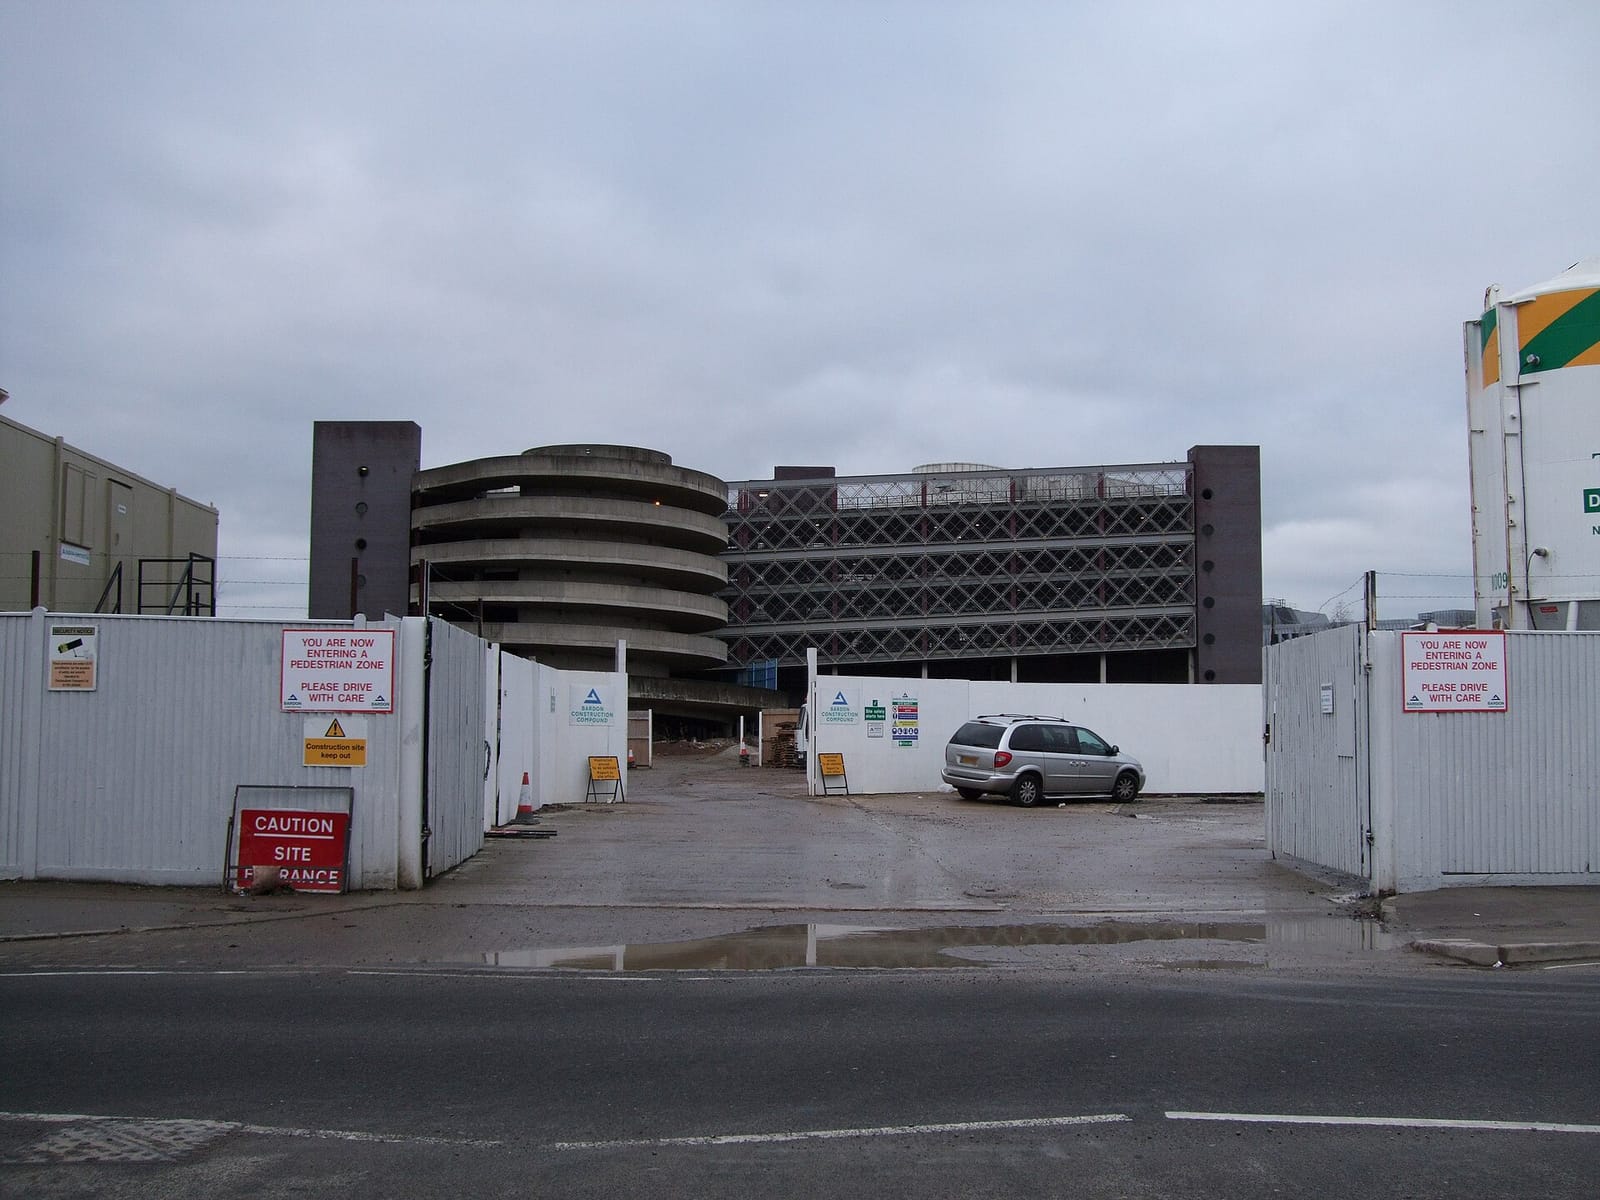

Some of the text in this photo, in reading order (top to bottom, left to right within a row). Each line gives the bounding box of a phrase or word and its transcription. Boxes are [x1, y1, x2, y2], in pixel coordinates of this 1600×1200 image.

[302, 639, 374, 647] YOU ARE NOW
[291, 660, 384, 669] PEDESTRIAN ZONE
[301, 683, 372, 691] PLEASE DRIVE
[309, 694, 365, 702] WITH CARE
[256, 816, 333, 833] CAUTION
[275, 846, 311, 861] SITE
[244, 868, 338, 884] ERANCE
